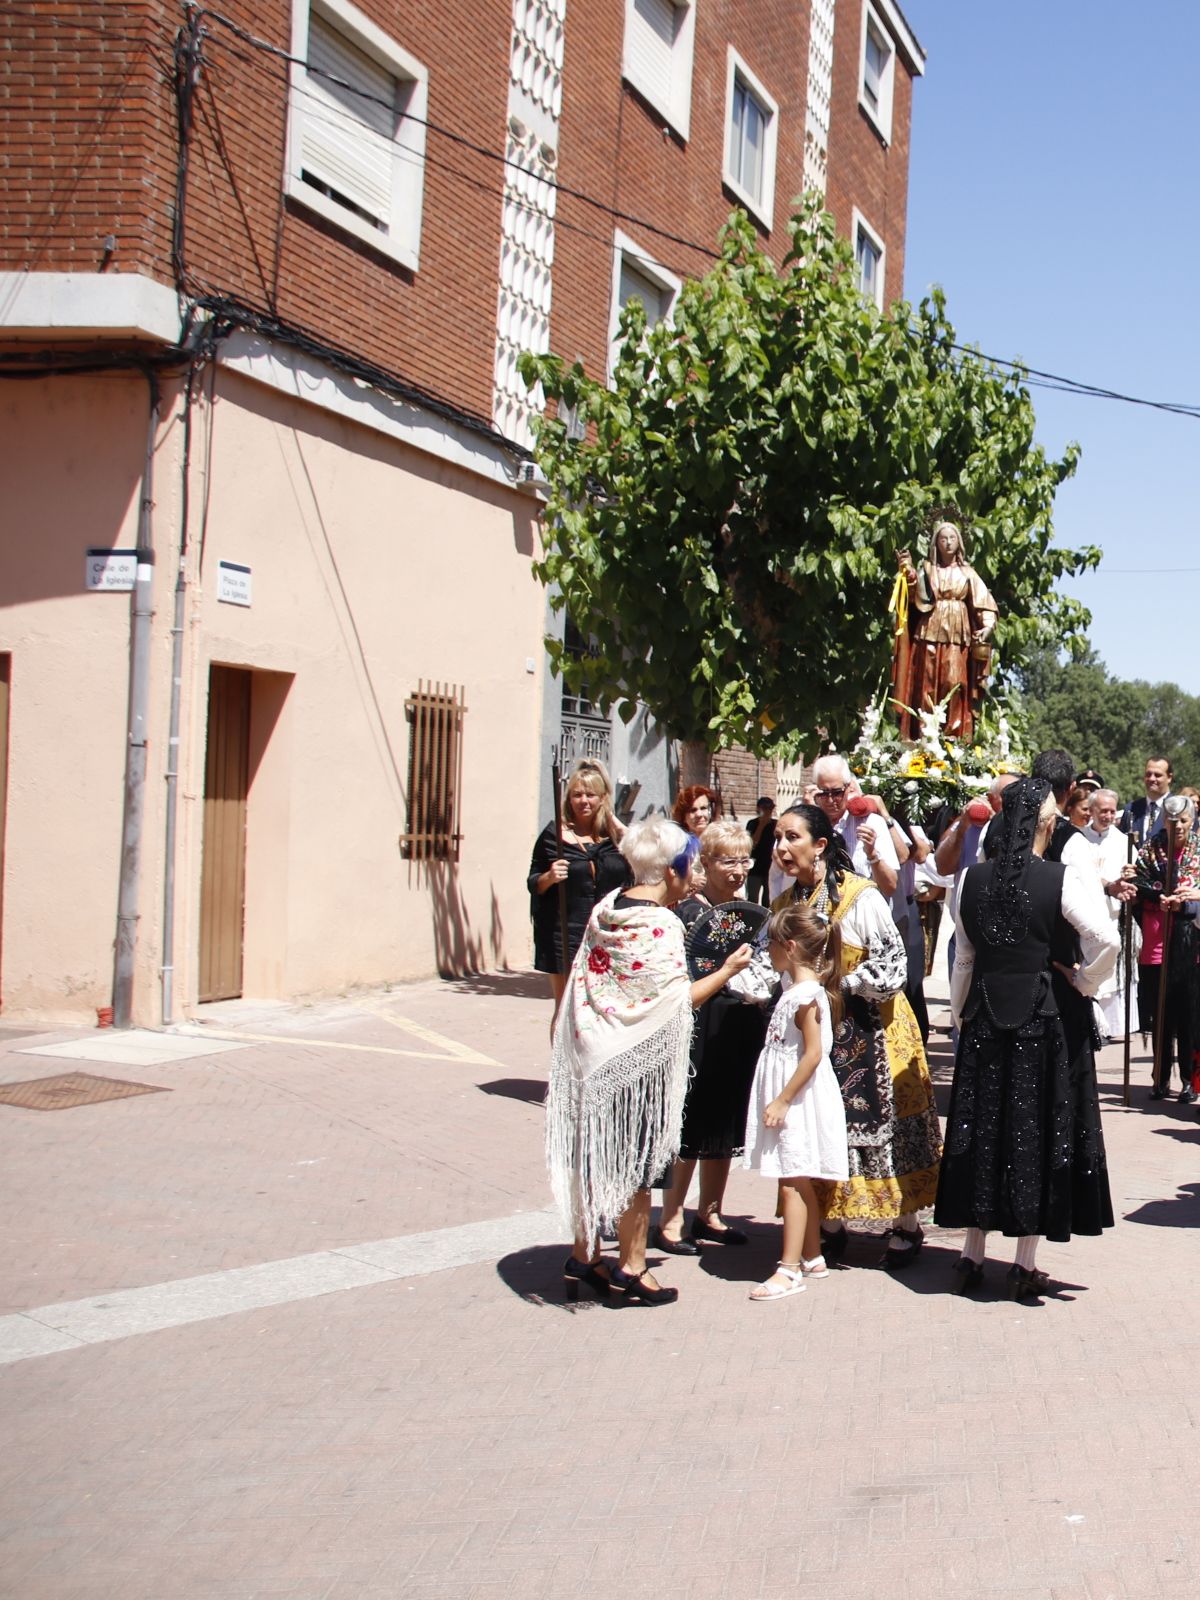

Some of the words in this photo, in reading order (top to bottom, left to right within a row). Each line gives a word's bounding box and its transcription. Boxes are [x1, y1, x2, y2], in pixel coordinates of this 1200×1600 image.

[93, 563, 115, 572] Calle
[119, 563, 129, 572] de
[93, 575, 104, 585] La
[106, 576, 135, 586] Iglesia
